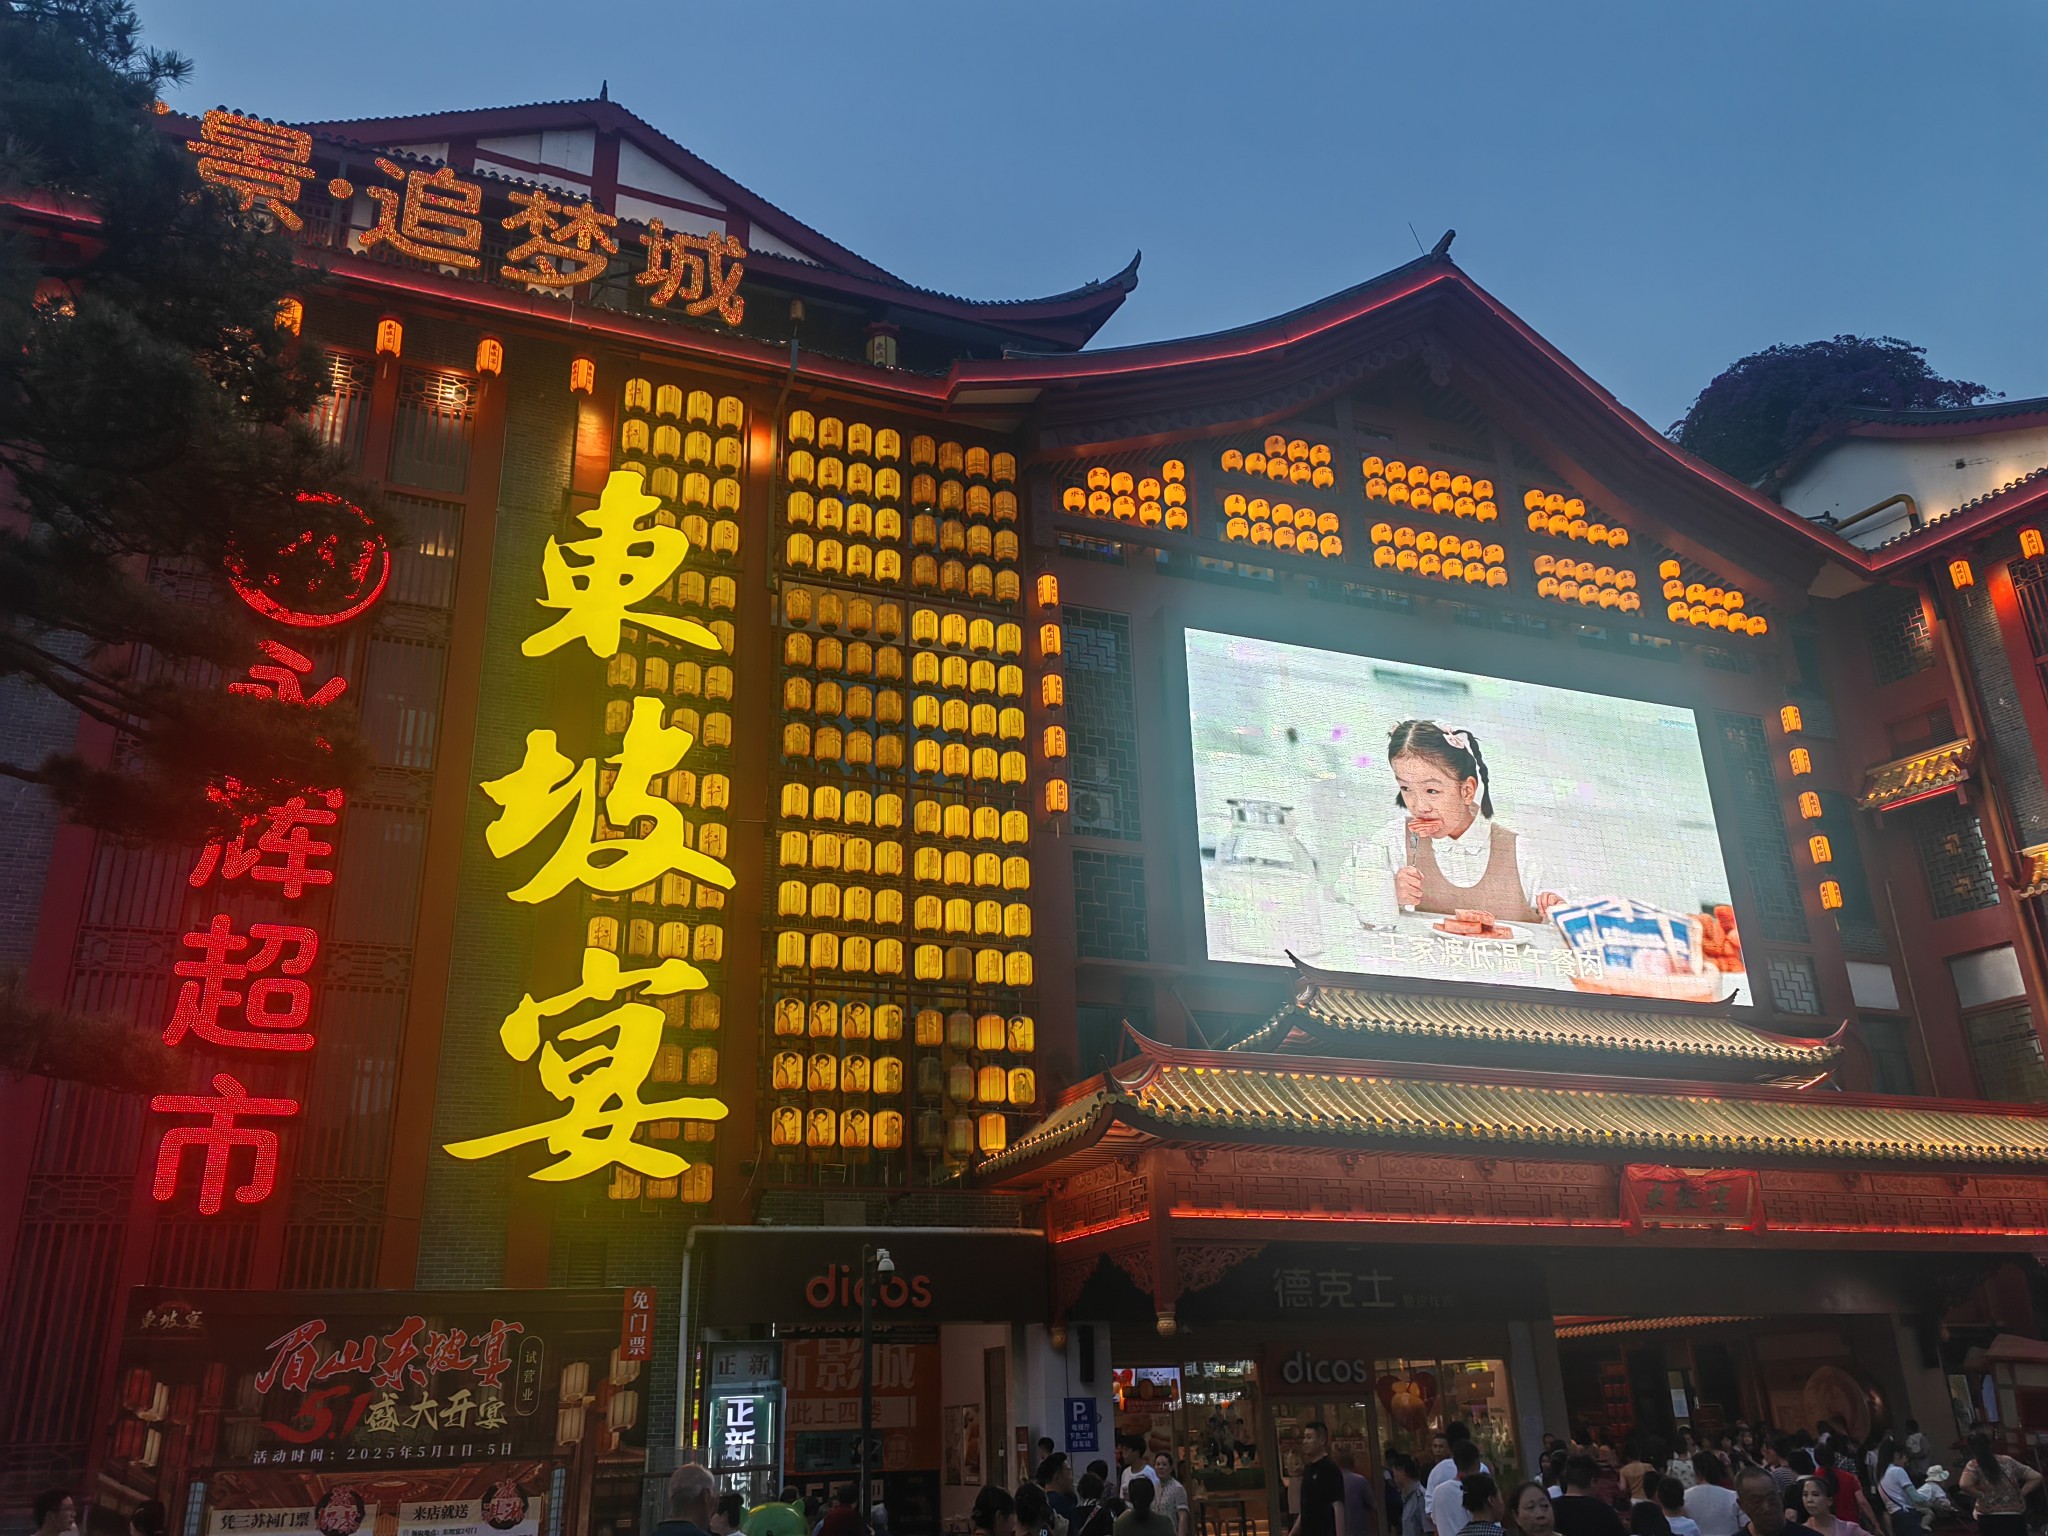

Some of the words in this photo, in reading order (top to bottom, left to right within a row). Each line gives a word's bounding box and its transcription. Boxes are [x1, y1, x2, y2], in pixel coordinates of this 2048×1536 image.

[1378, 931, 1604, 980] 王家渡低温午餐肉
[806, 1264, 932, 1309] dicos
[1272, 1267, 1396, 1309] 德克士
[627, 1290, 650, 1356] 免门票
[255, 1315, 524, 1394] 眉山东坡宴
[522, 1350, 538, 1402] 试营业
[719, 1354, 769, 1376] 正新
[1282, 1351, 1368, 1385] dicos
[260, 1385, 374, 1445] 5.1
[364, 1388, 508, 1434] 盛大开宴
[1073, 1401, 1086, 1422] P
[221, 1512, 310, 1530] 凭三苏祠门票
[413, 1504, 470, 1521] 来店就送
